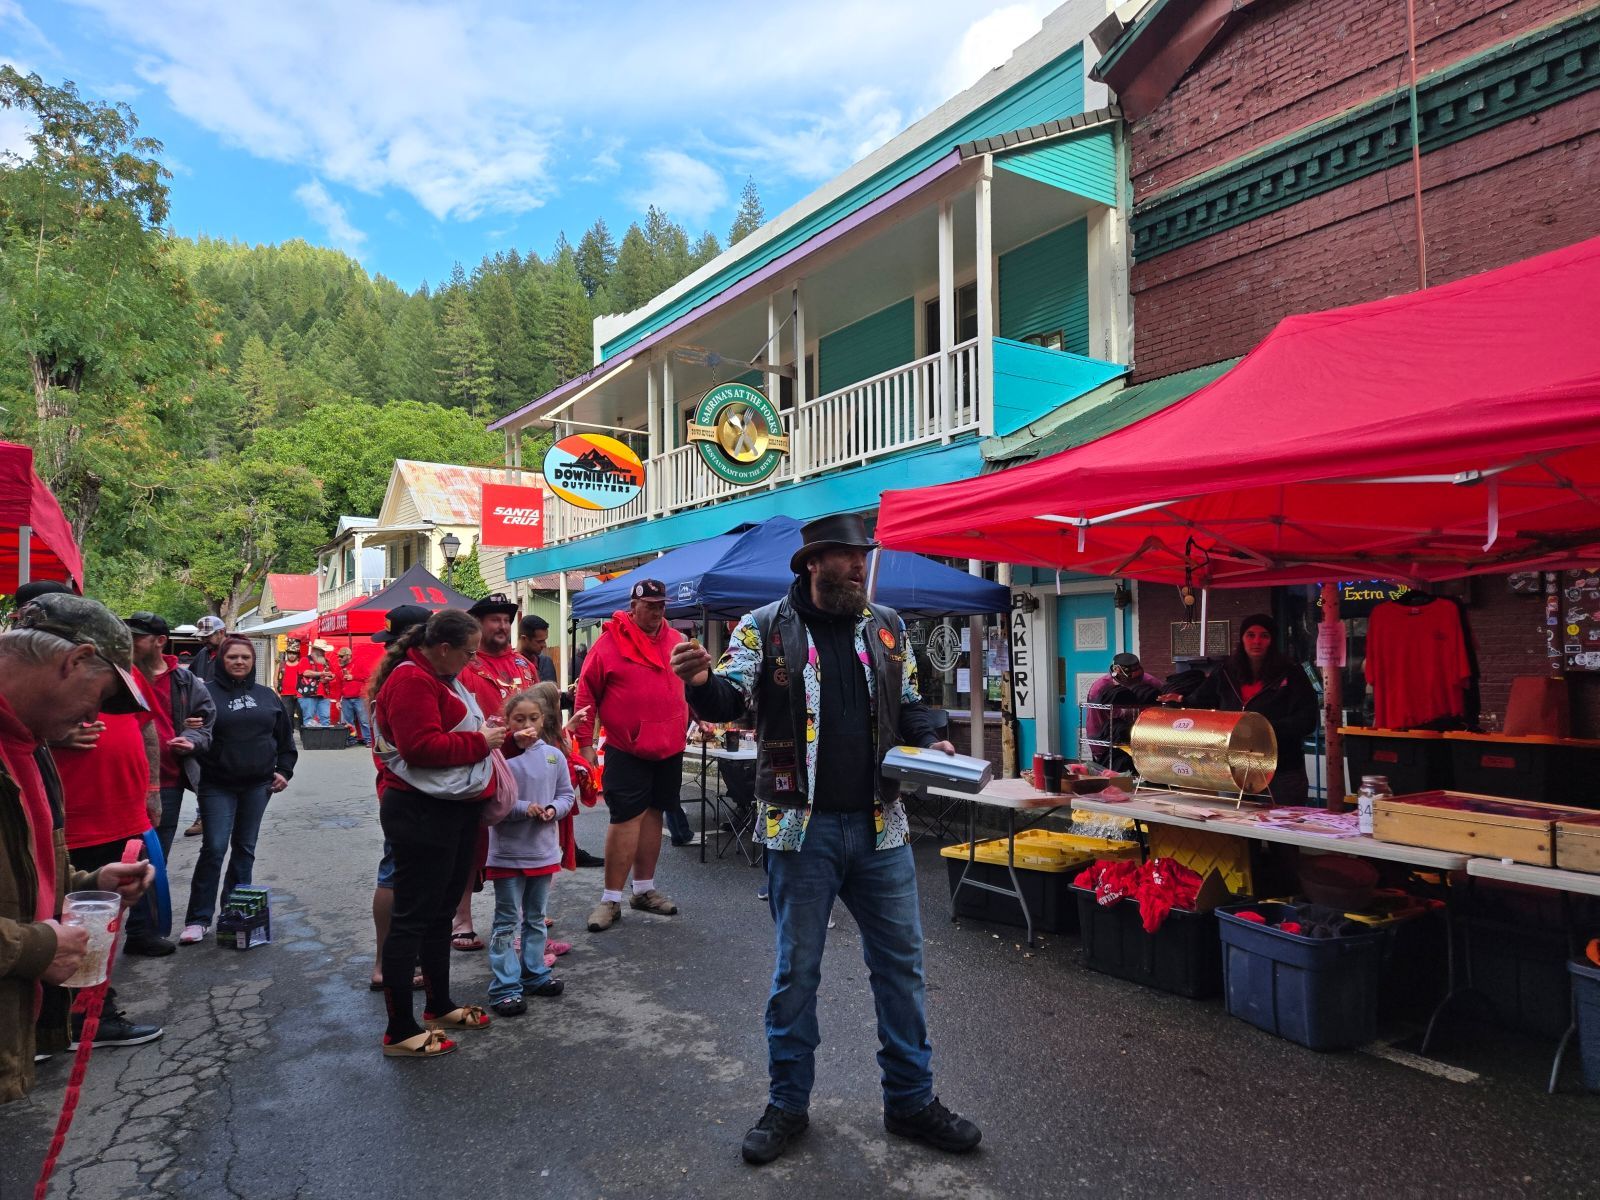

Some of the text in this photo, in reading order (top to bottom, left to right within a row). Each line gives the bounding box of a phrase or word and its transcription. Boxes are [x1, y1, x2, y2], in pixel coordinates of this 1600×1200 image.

[701, 388, 778, 434] SABRINA'S AT THE FORKS
[704, 443, 775, 479] RESTAURANT ON THE RIVER
[554, 468, 637, 486] DOWNIEVILLE
[562, 481, 630, 493] OUTFITTERS
[493, 506, 540, 517] SANTA
[502, 515, 540, 526] CRUZ
[1344, 586, 1385, 600] Extra
[1012, 593, 1029, 707] BAKERY
